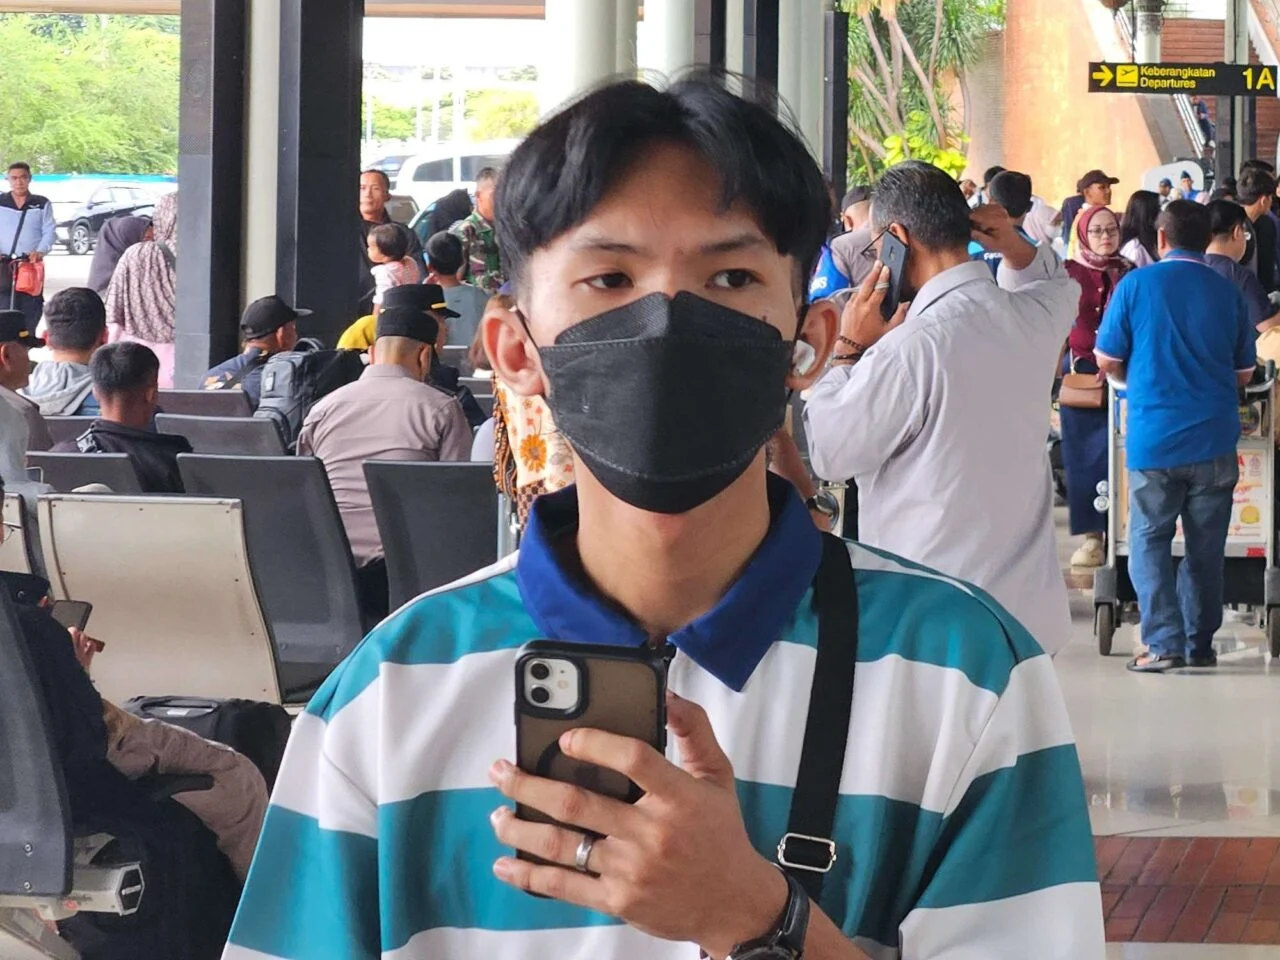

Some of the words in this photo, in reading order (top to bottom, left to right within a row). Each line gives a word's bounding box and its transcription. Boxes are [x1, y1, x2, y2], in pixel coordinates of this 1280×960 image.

[1140, 65, 1216, 79] Keberangkatan
[1242, 67, 1275, 90] 1A
[1140, 76, 1197, 89] Departures
